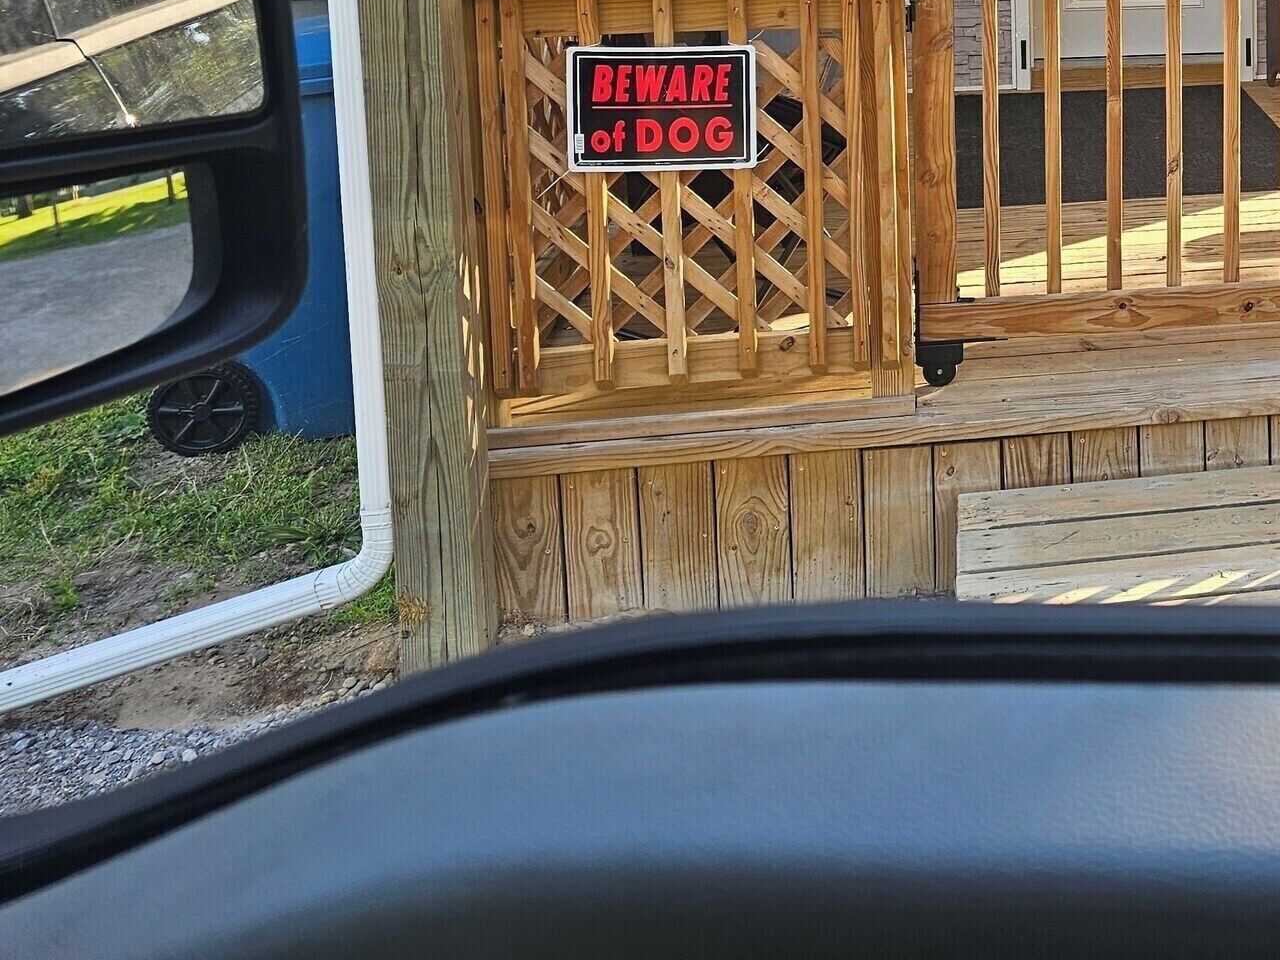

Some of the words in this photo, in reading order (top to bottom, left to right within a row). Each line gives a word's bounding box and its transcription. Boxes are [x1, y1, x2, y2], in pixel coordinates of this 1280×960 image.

[591, 63, 732, 103] BEWARE
[590, 120, 626, 154] of
[636, 116, 734, 153] DOG
